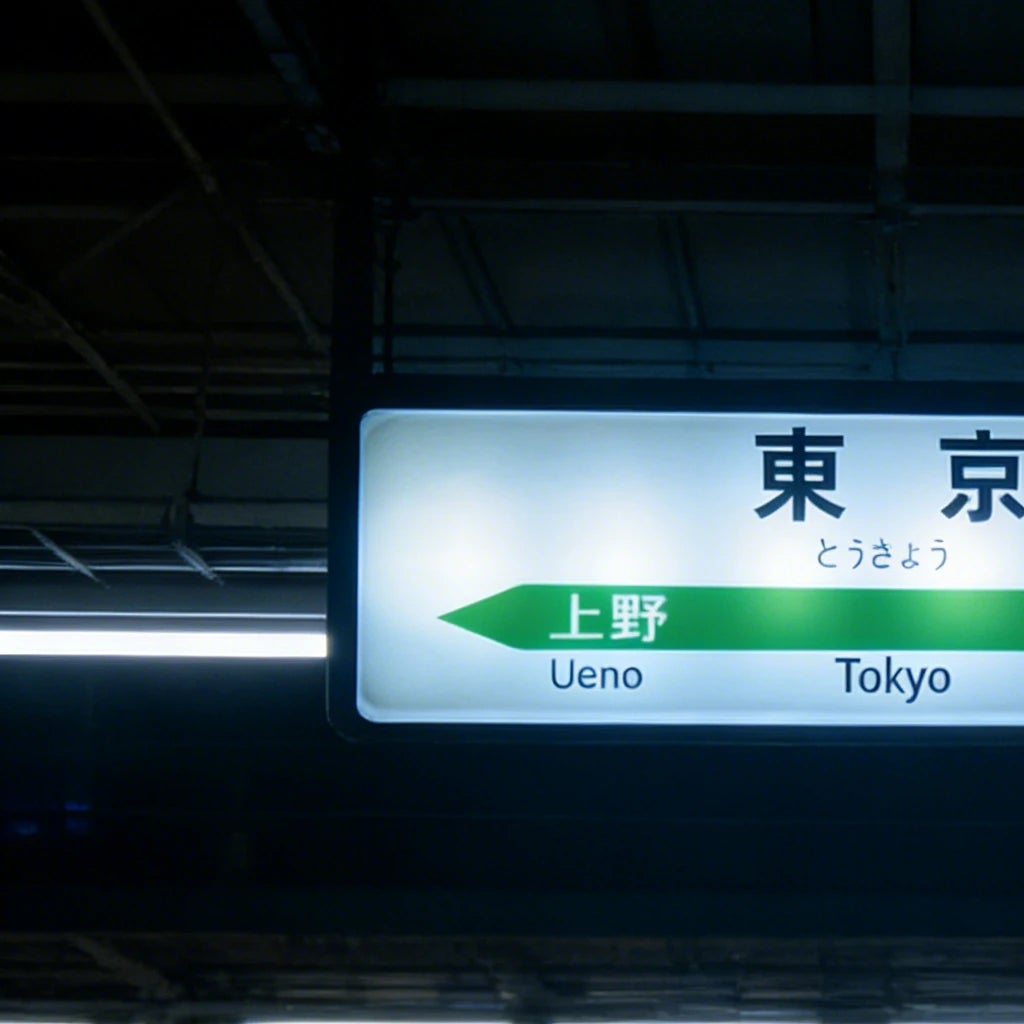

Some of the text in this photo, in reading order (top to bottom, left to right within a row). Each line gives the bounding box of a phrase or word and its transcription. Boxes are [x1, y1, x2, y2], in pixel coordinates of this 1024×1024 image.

[549, 592, 668, 643] 上野
[551, 658, 642, 689] Ueno
[835, 656, 951, 704] Tokyo
